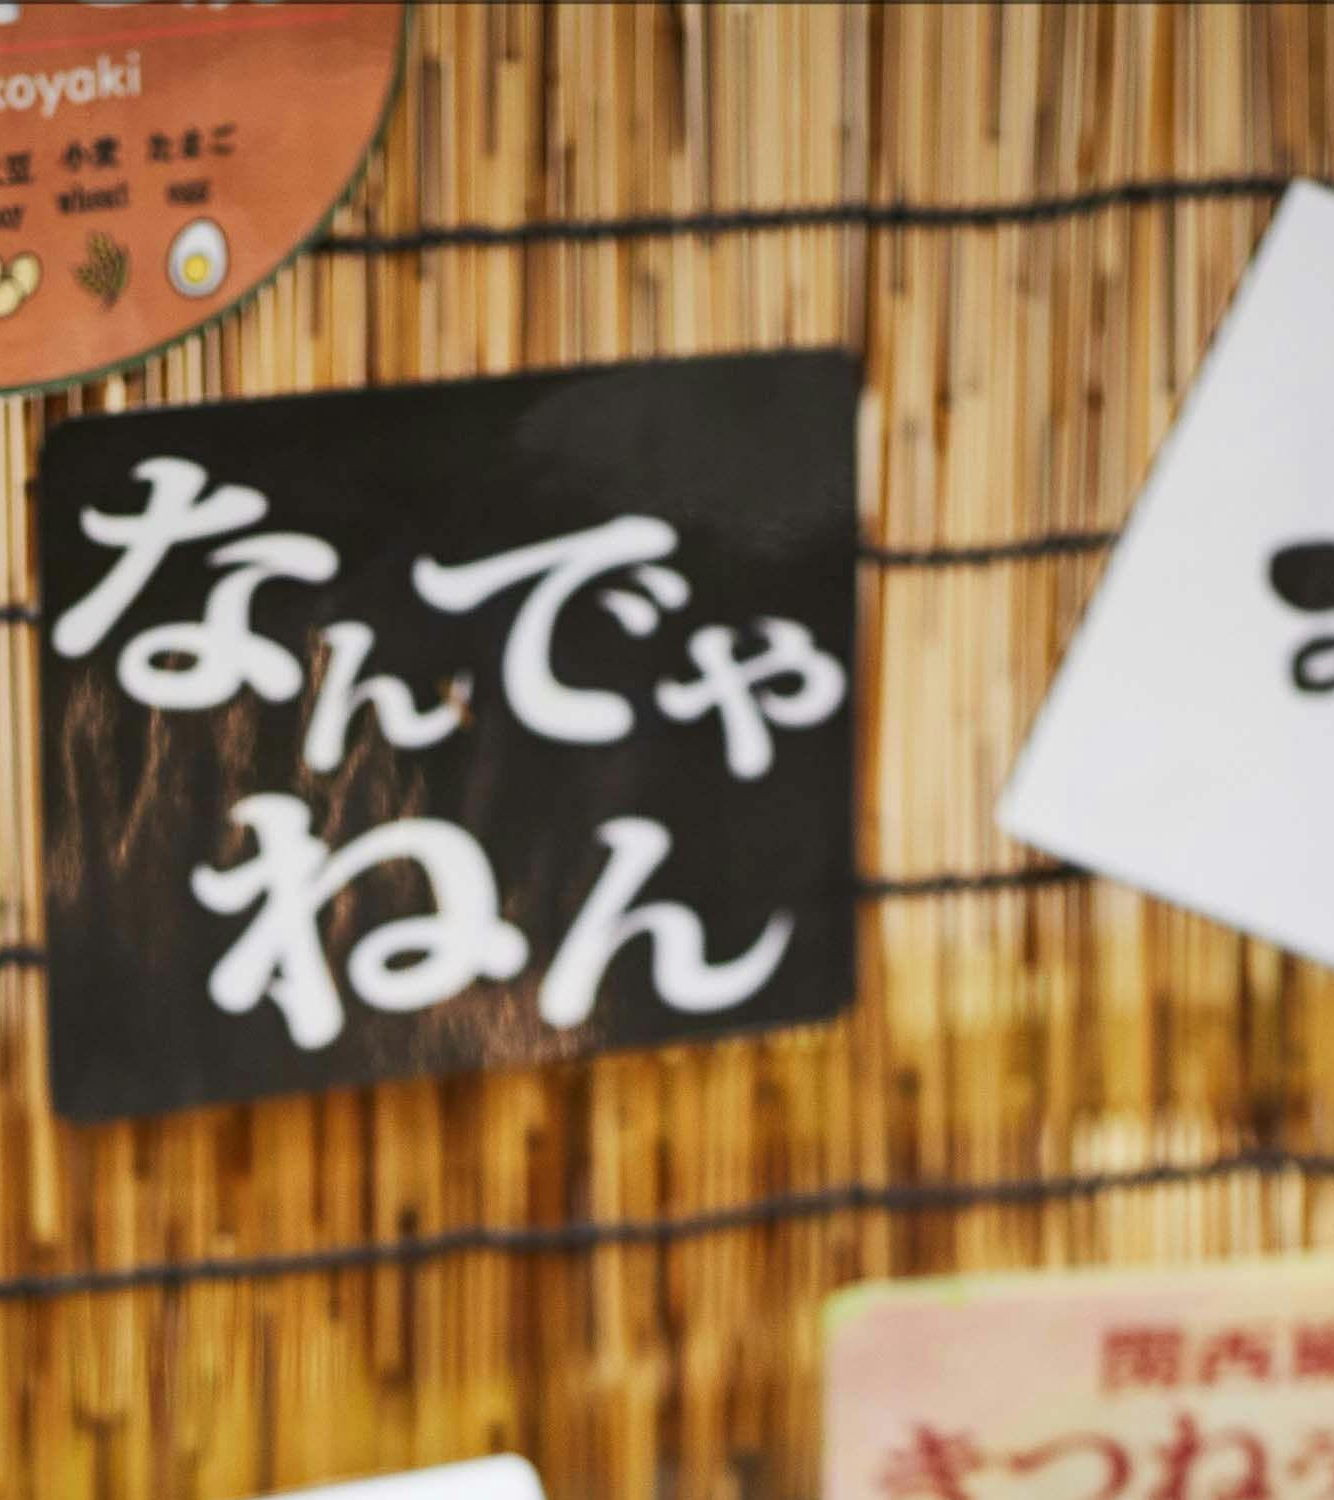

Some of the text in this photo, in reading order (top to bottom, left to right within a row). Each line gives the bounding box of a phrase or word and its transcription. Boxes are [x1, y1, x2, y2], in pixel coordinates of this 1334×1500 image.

[51, 455, 849, 781] なんでや
[189, 792, 797, 1052] ねん
